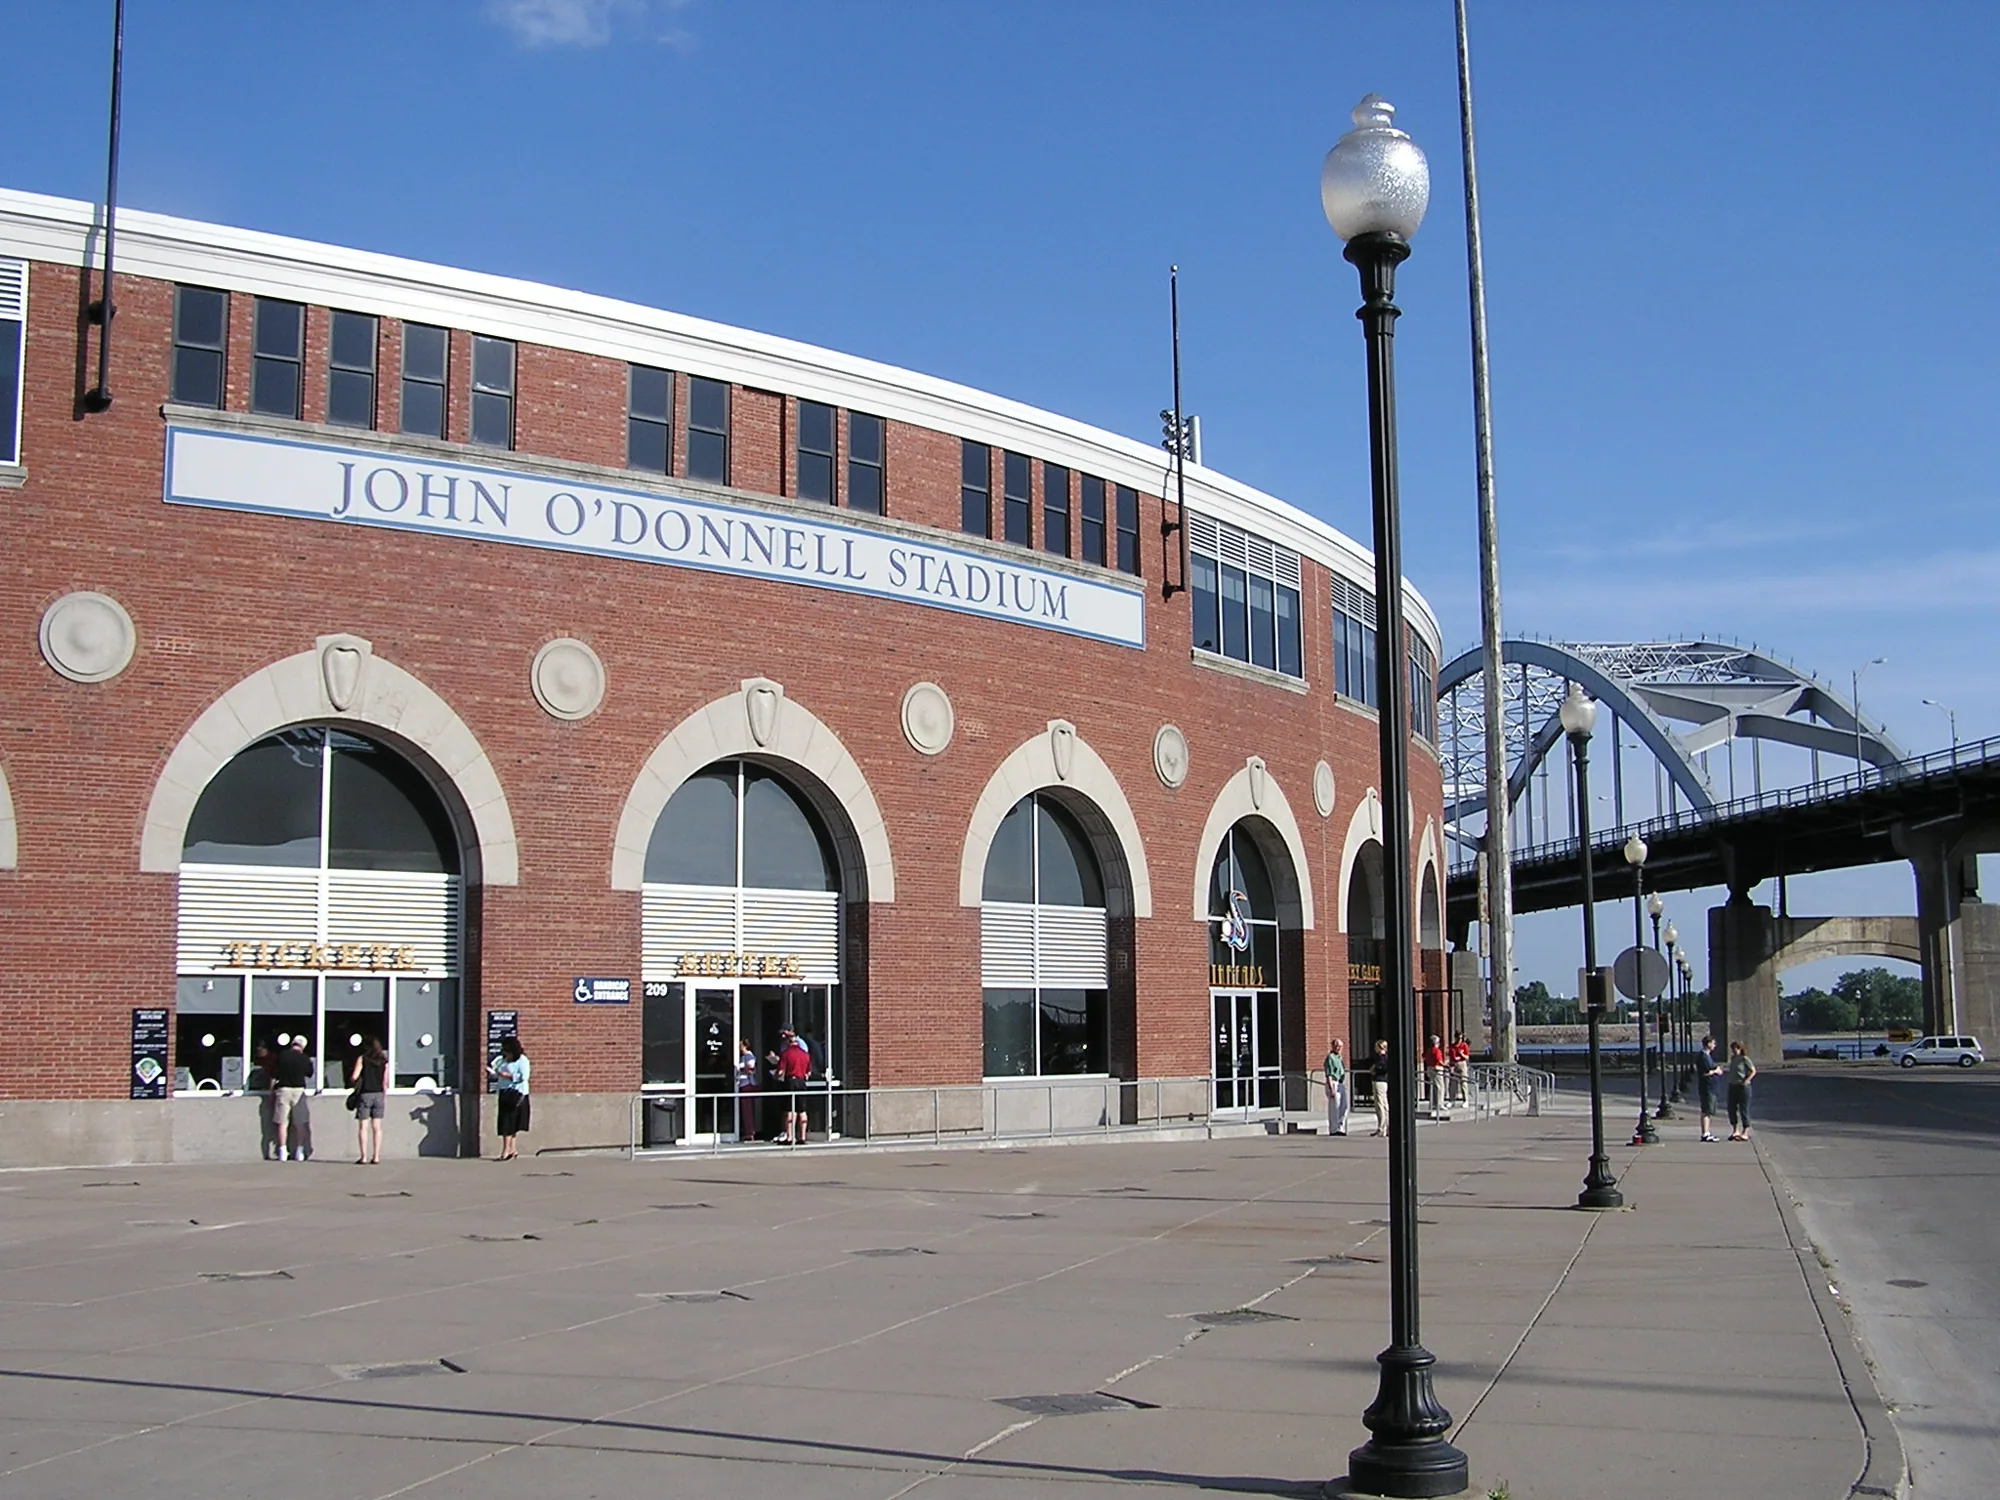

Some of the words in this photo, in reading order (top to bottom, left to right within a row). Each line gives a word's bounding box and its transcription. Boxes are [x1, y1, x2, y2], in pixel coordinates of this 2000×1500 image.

[333, 461, 513, 528] JOHN
[545, 492, 867, 581] O'DONNELL
[888, 548, 1070, 622] STADIUM
[228, 941, 416, 968] TICKETS
[682, 952, 800, 976] SUITES
[1211, 964, 1264, 986] THREADS
[206, 980, 214, 991] 1
[280, 981, 290, 991] 2
[352, 982, 362, 993] 3
[420, 982, 431, 993] 4
[645, 982, 668, 997] 209
